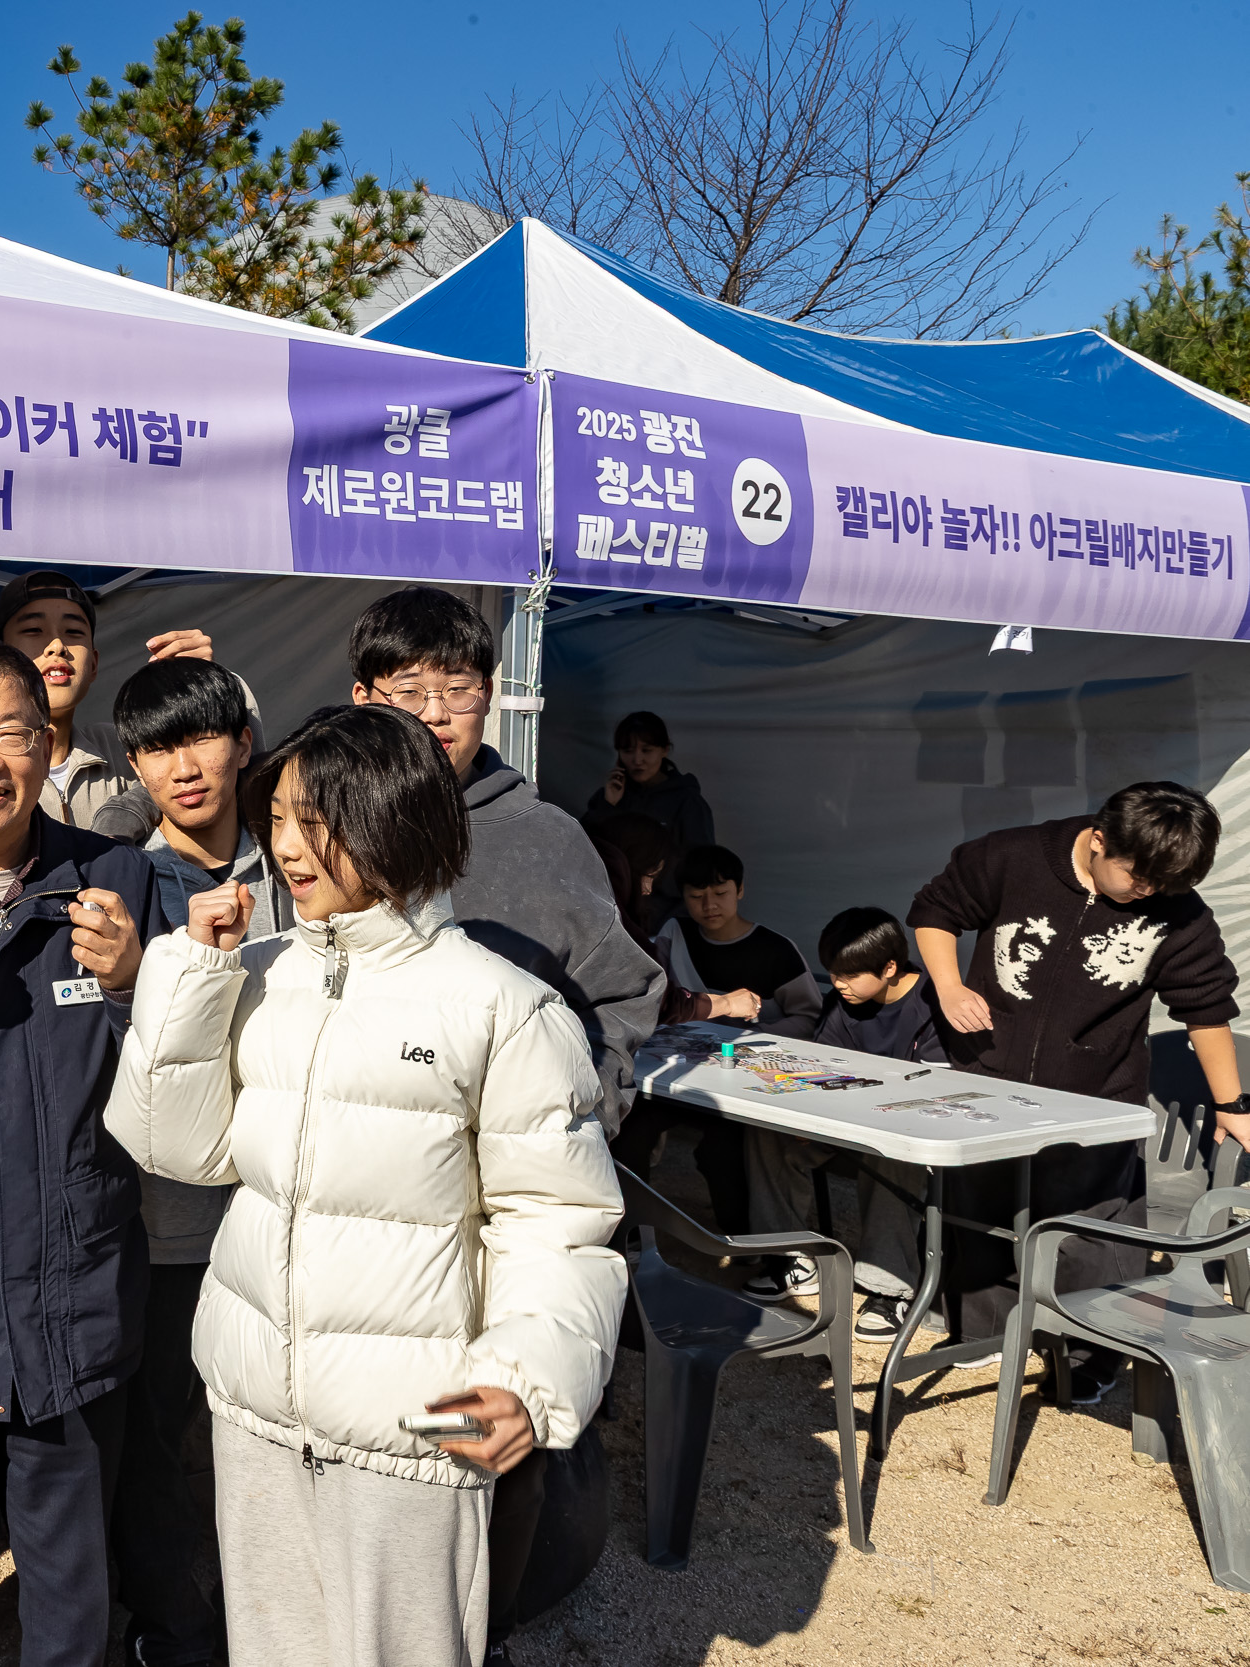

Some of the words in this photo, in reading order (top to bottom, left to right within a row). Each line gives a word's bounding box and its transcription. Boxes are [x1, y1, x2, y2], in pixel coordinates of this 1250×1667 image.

[383, 404, 452, 459] 광클
[576, 406, 637, 442] 2025
[639, 409, 707, 459] 광진
[302, 464, 525, 530] 제로원코드랩
[595, 456, 695, 513] 청소년
[741, 479, 783, 522] 22
[575, 514, 708, 571] 페스티벌
[835, 485, 934, 547] 캘리야
[940, 498, 1020, 554] 놀자!!
[1029, 511, 1234, 580] 아크릴배지만들기
[400, 1041, 435, 1065] Lee
